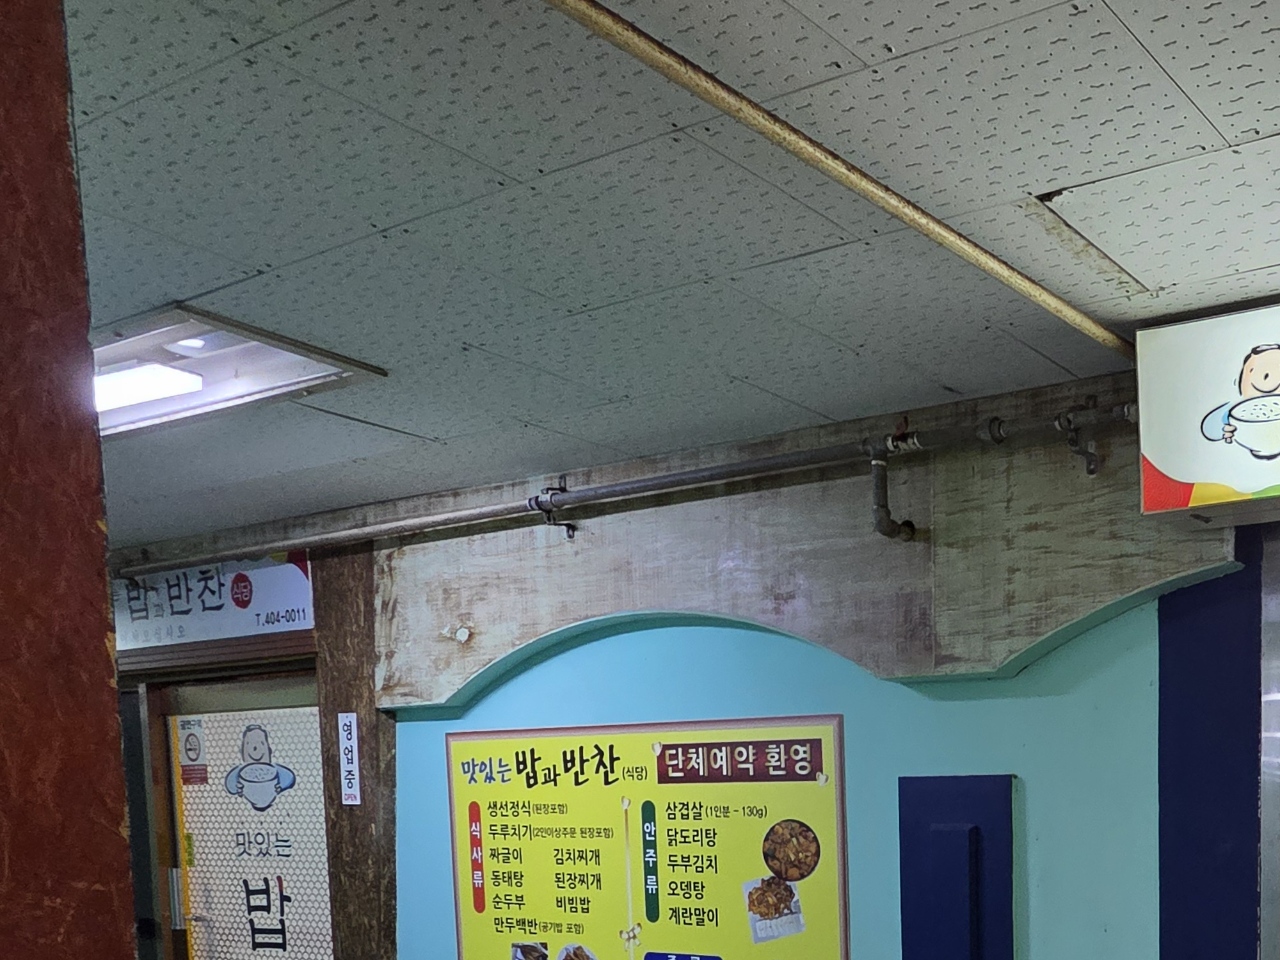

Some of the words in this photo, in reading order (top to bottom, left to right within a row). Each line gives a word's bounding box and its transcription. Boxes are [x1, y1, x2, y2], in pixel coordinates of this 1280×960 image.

[232, 580, 250, 601] 식당
[255, 607, 306, 627] T.404-0011
[342, 720, 356, 789] 영업중
[664, 745, 756, 777] 단체예약
[765, 743, 812, 777] 환영
[461, 757, 512, 785] 맛있는
[621, 766, 648, 781] (식당)
[487, 800, 531, 817] 생선정식
[665, 801, 703, 821] 삼겹살
[235, 831, 292, 857] 맛있는
[667, 827, 718, 847] 닭도리탕
[489, 847, 523, 864] 짜글이
[553, 848, 601, 866] 김치찌개
[667, 854, 718, 874] 두부김치
[490, 870, 524, 888] 동태탕
[554, 872, 602, 890] 된장찌개
[667, 880, 706, 900] 오뎅탕
[492, 894, 526, 910] 순두부
[556, 896, 591, 913] 비빔밥
[494, 917, 537, 935] 만두백반
[668, 907, 719, 927] 계란말이
